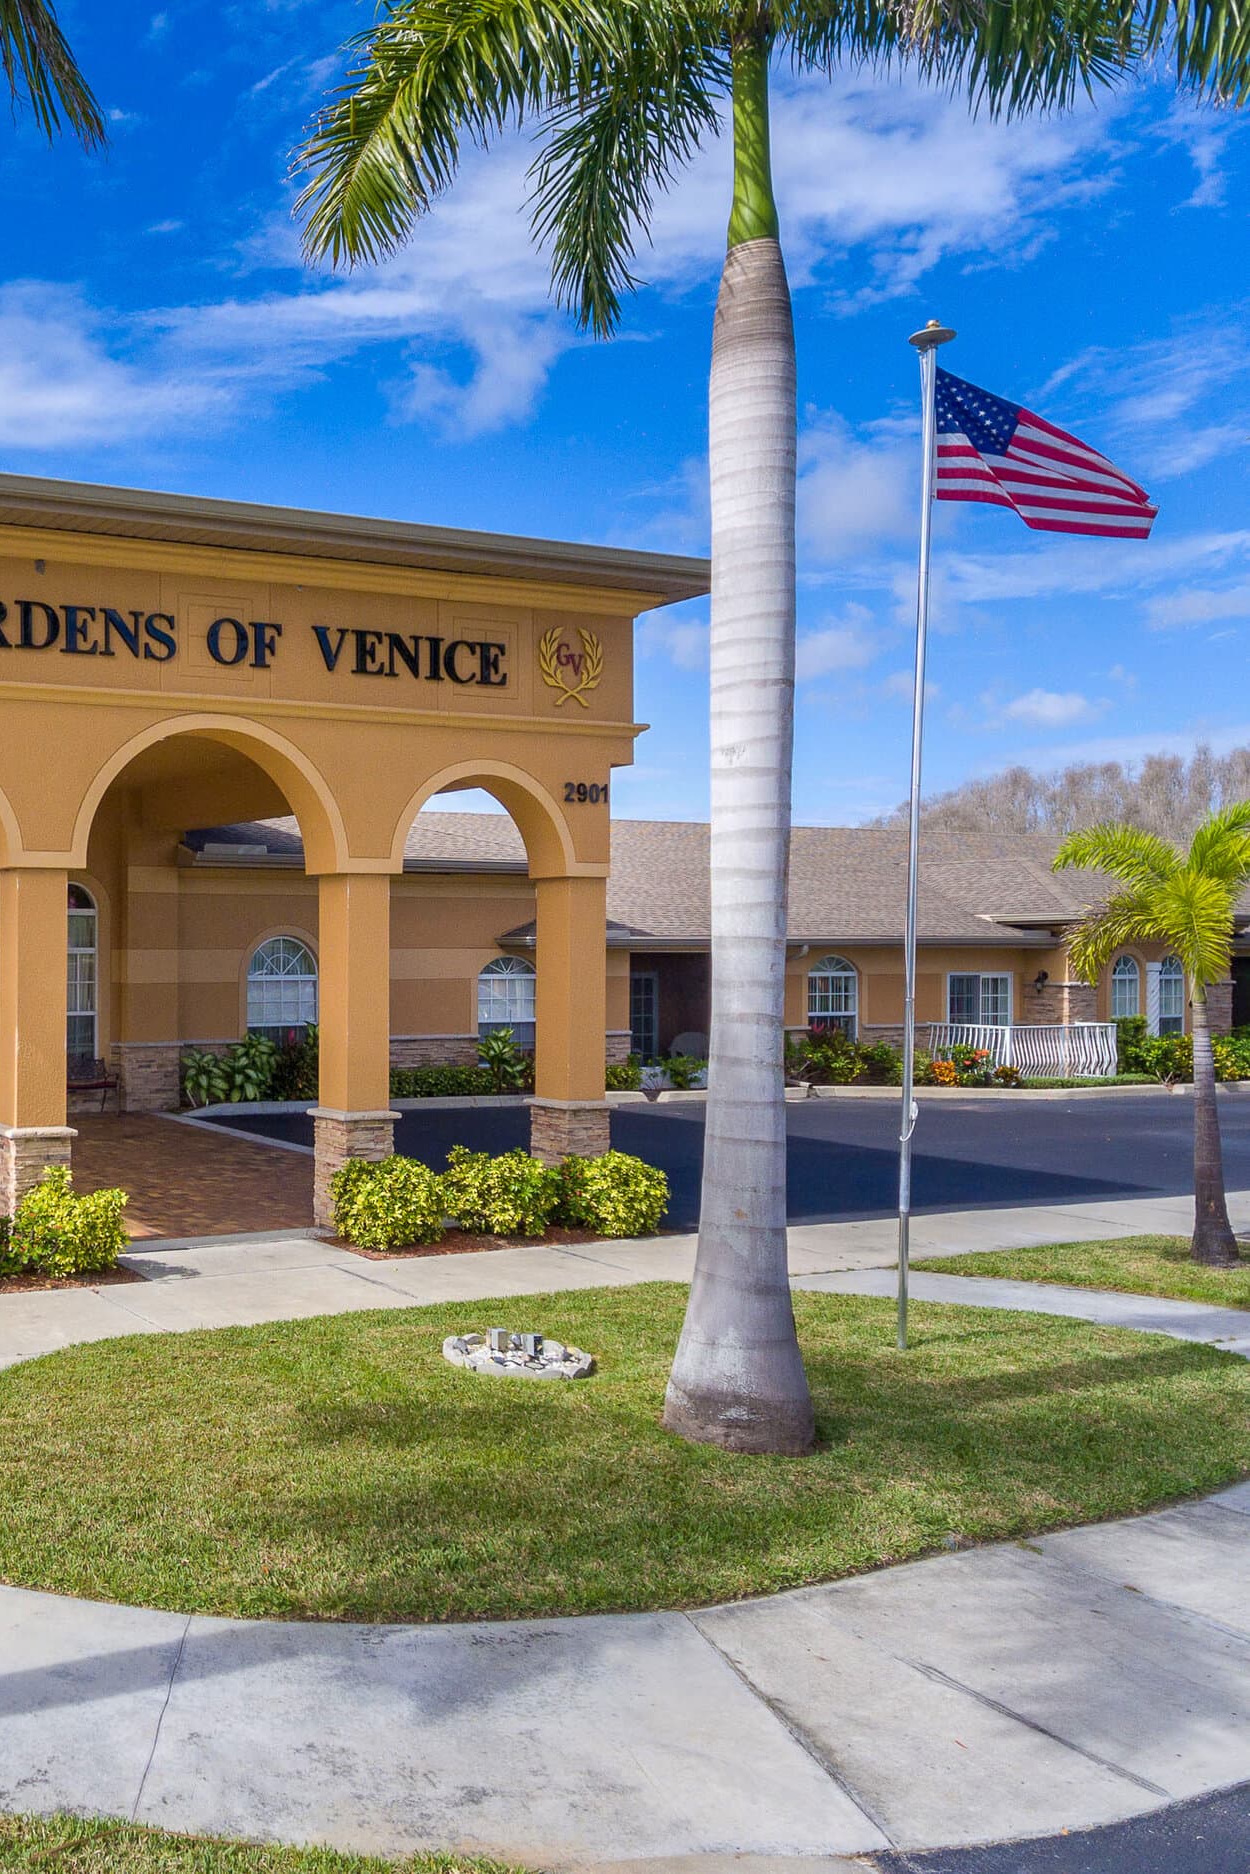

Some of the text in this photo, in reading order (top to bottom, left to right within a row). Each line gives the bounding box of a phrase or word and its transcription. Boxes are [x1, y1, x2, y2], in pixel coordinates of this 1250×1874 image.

[206, 617, 283, 669] OF
[311, 625, 508, 686] VENICE
[557, 643, 584, 676] GV
[564, 782, 608, 804] 2901
